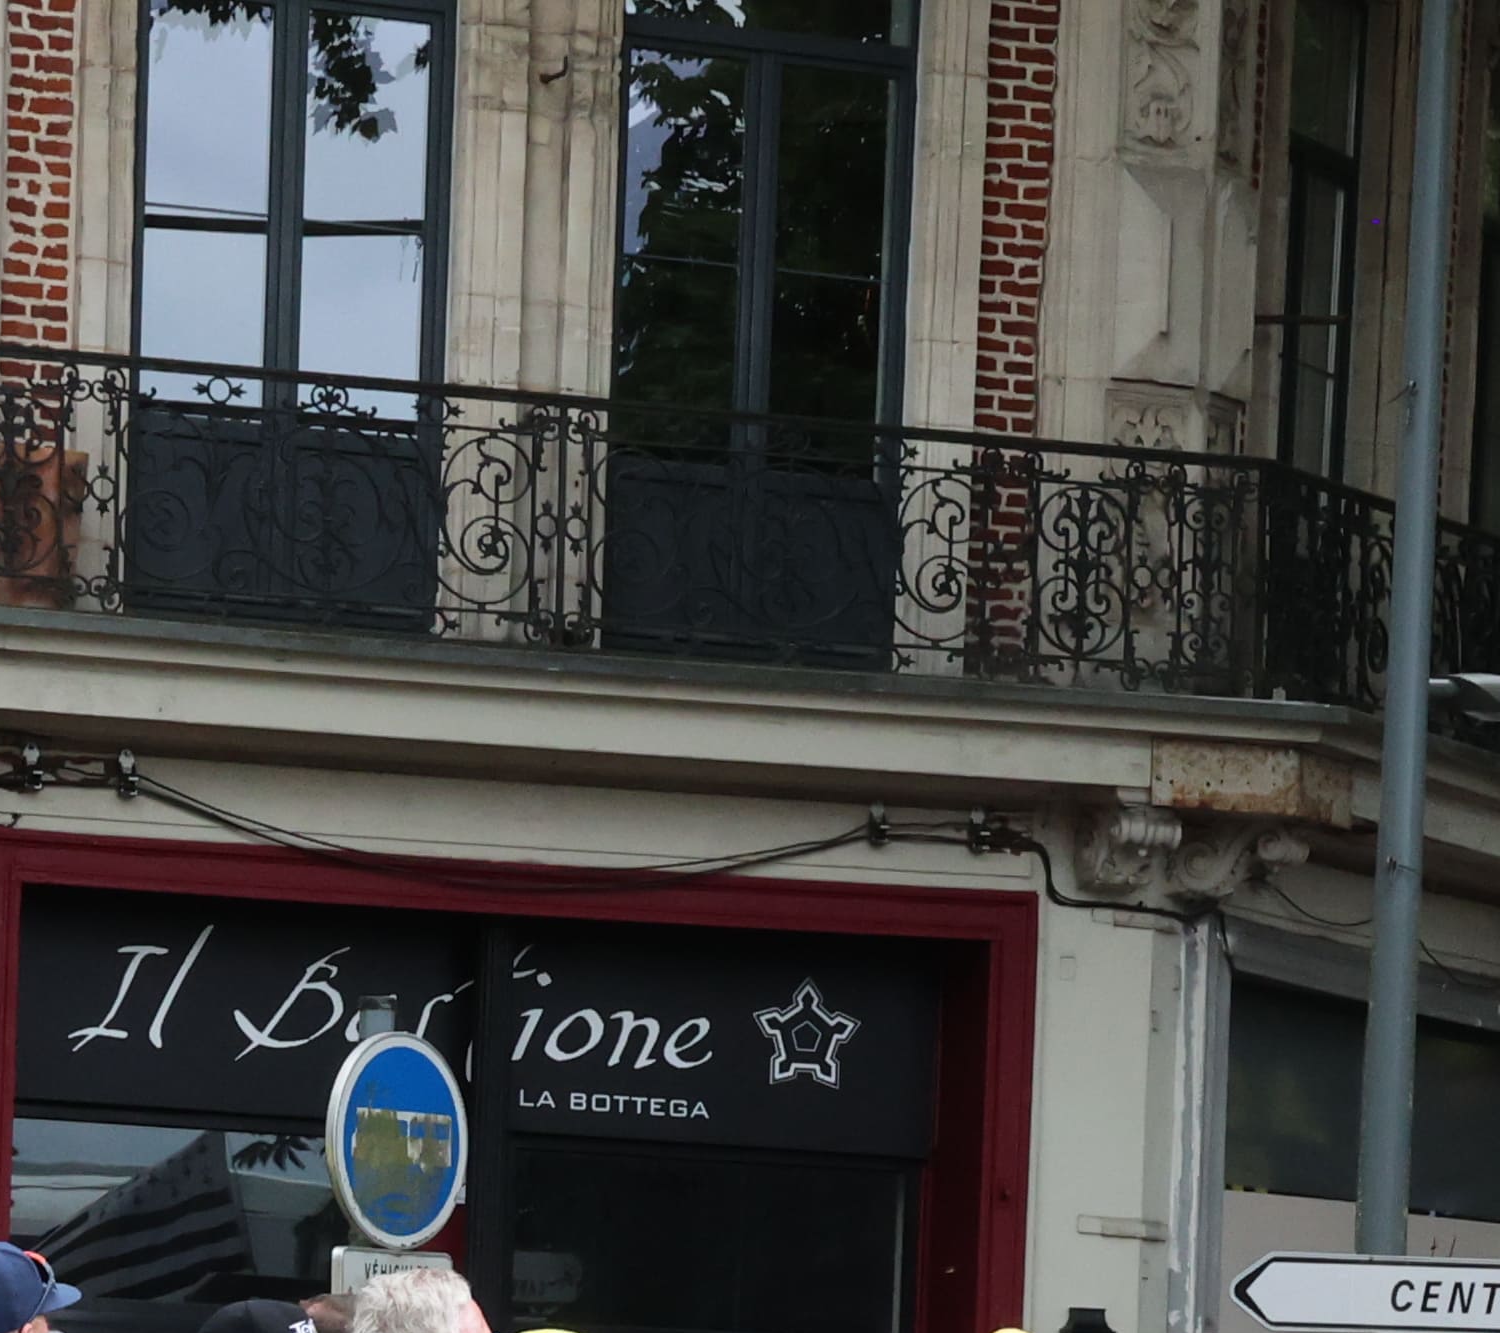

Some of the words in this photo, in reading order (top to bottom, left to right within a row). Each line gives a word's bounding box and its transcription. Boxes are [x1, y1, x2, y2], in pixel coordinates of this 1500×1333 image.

[67, 924, 215, 1052] Il
[520, 1089, 555, 1111] LA
[569, 1092, 710, 1119] BOTTEGA
